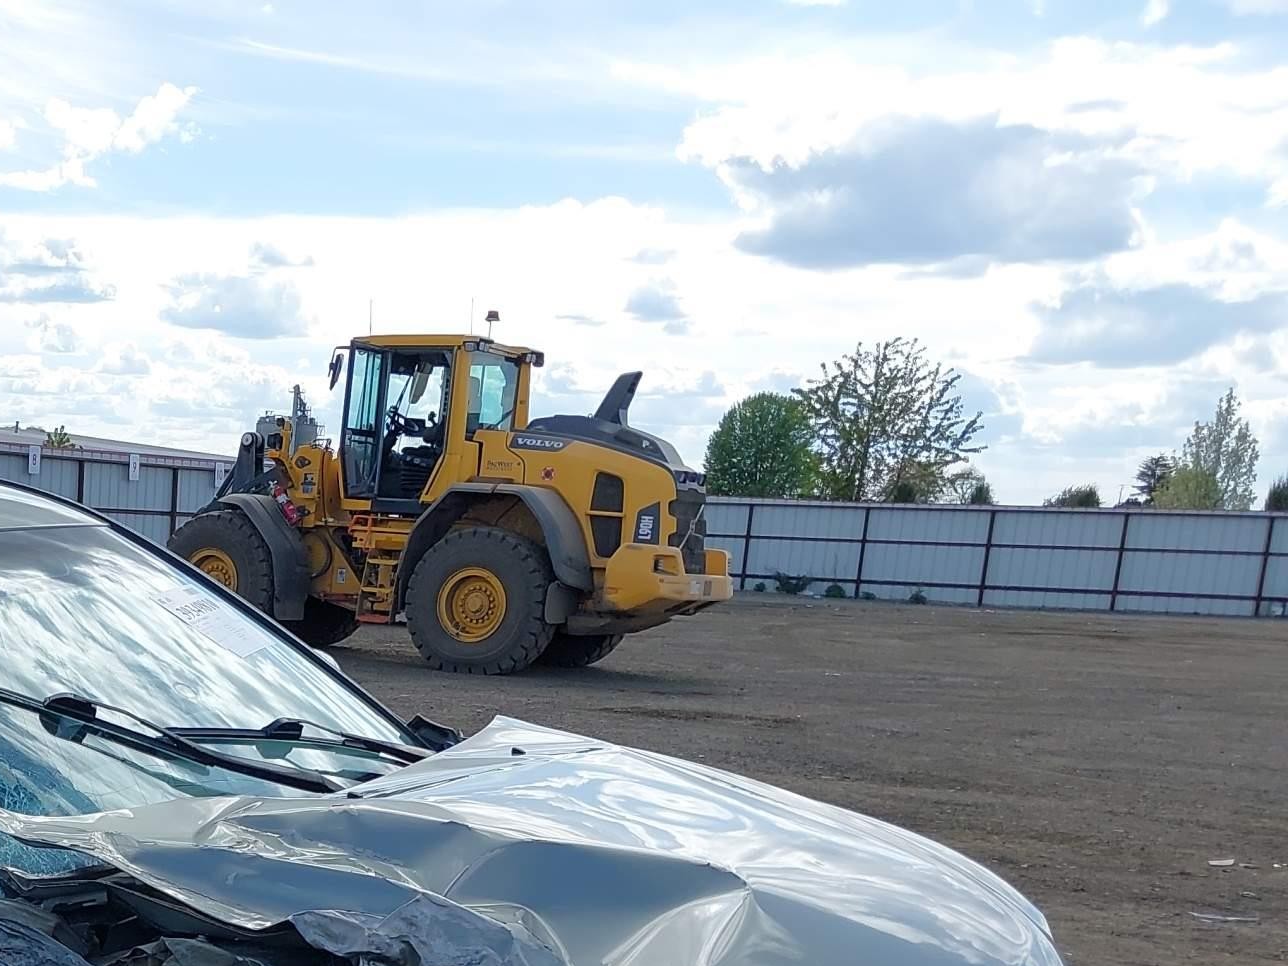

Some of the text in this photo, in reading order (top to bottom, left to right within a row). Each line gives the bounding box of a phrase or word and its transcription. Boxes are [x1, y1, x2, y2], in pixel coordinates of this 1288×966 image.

[516, 437, 564, 448] VOLVO
[32, 453, 37, 466] 8
[637, 515, 654, 540] L90H
